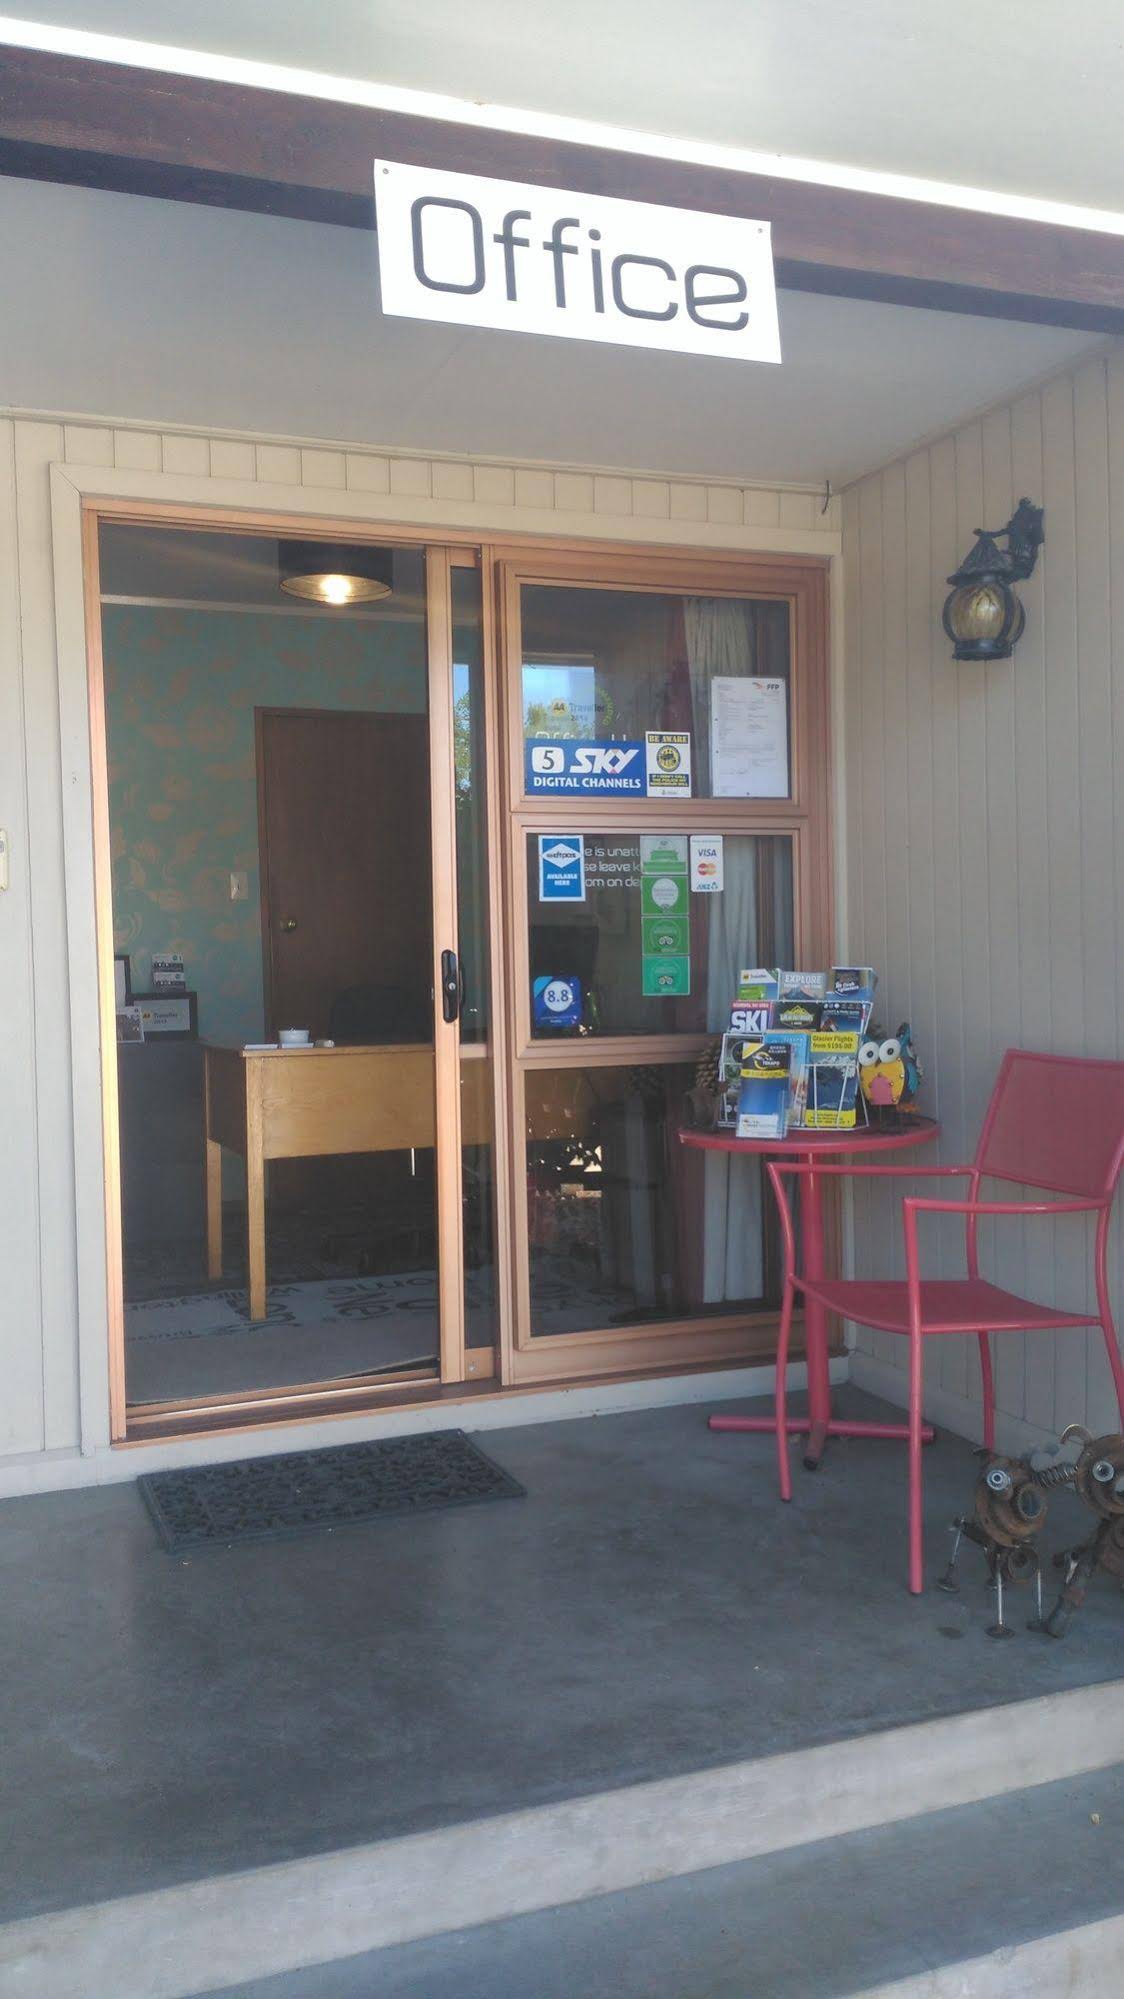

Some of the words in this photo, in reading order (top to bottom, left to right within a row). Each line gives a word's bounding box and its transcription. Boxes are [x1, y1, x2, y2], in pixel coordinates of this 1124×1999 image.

[410, 195, 749, 332] Office
[542, 750, 555, 770] 5
[570, 748, 640, 774] SKY
[534, 776, 580, 787] DIGITAL
[582, 777, 641, 789] CHANNELS
[595, 847, 604, 856] is
[607, 847, 640, 857] unatt
[698, 849, 718, 857] VISA
[585, 862, 597, 872] se
[598, 861, 631, 872] leave
[585, 878, 605, 887] om
[607, 878, 622, 887] on
[624, 876, 641, 887] de
[784, 974, 822, 985] EXPLORE
[547, 989, 569, 1003] 8.8
[731, 1010, 767, 1033] SKI
